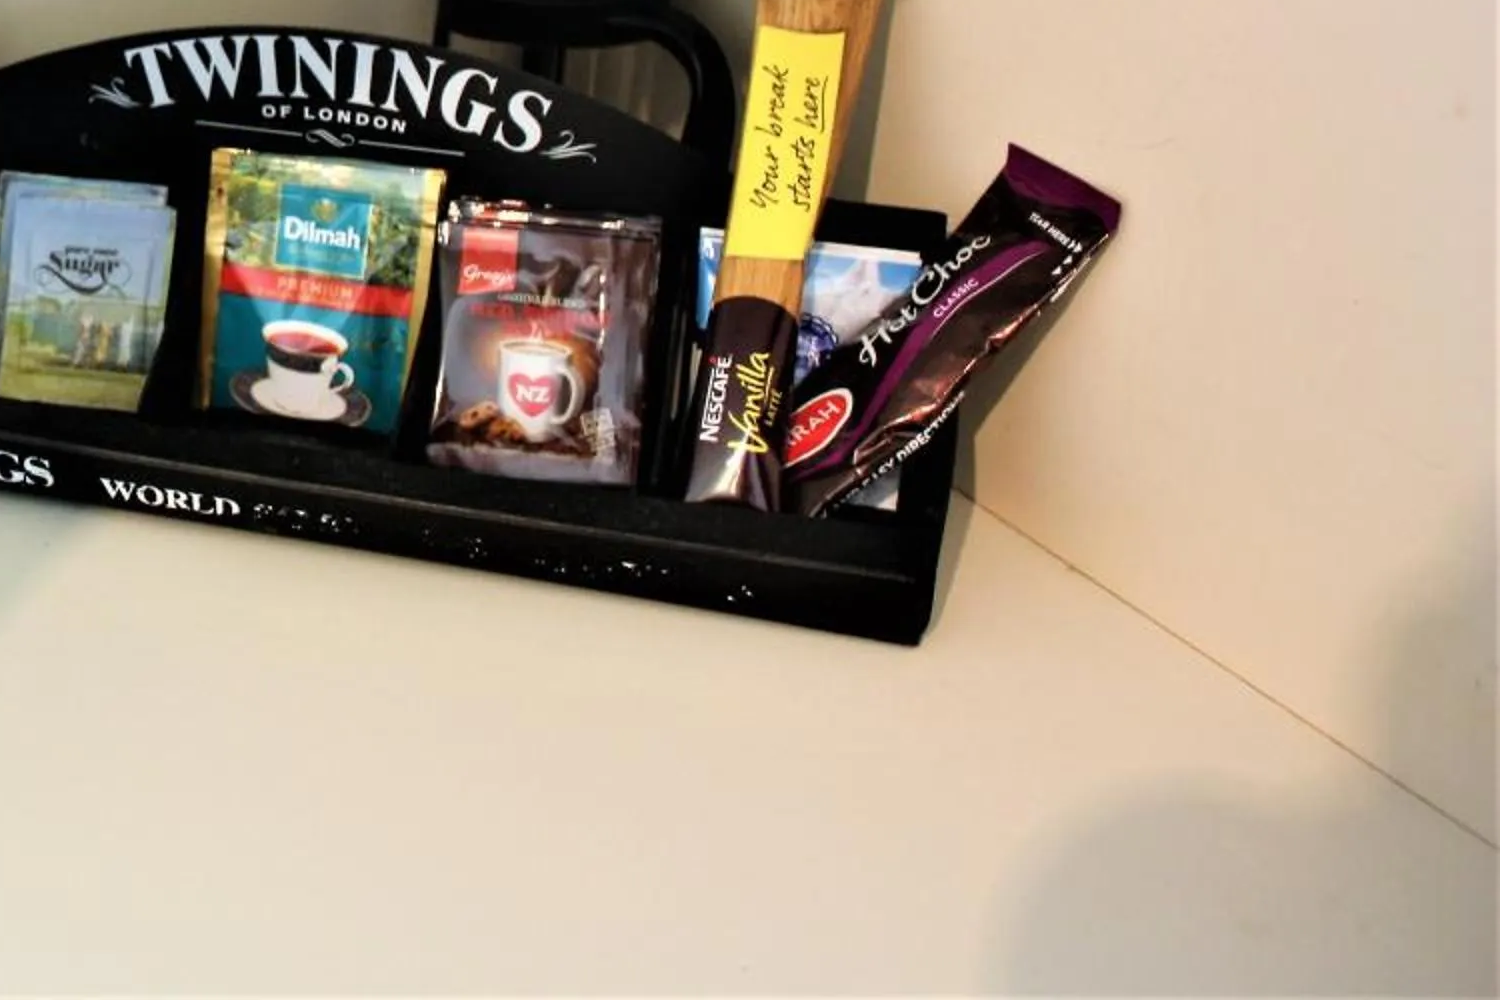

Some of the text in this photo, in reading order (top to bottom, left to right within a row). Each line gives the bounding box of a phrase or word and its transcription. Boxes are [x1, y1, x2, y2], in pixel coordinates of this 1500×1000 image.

[124, 34, 553, 154] TWININGS
[261, 104, 407, 134] OF LONDON
[749, 64, 789, 209] Your break
[787, 76, 821, 213] starts here
[283, 216, 361, 251] Dilmah
[40, 250, 123, 294] Sugar
[859, 235, 991, 368] Hot Choc
[933, 277, 980, 319] CLASSIC
[515, 384, 550, 404] NZ
[727, 352, 771, 454] Vanilla
[787, 402, 841, 447] RAH
[100, 477, 241, 516] WORLD
